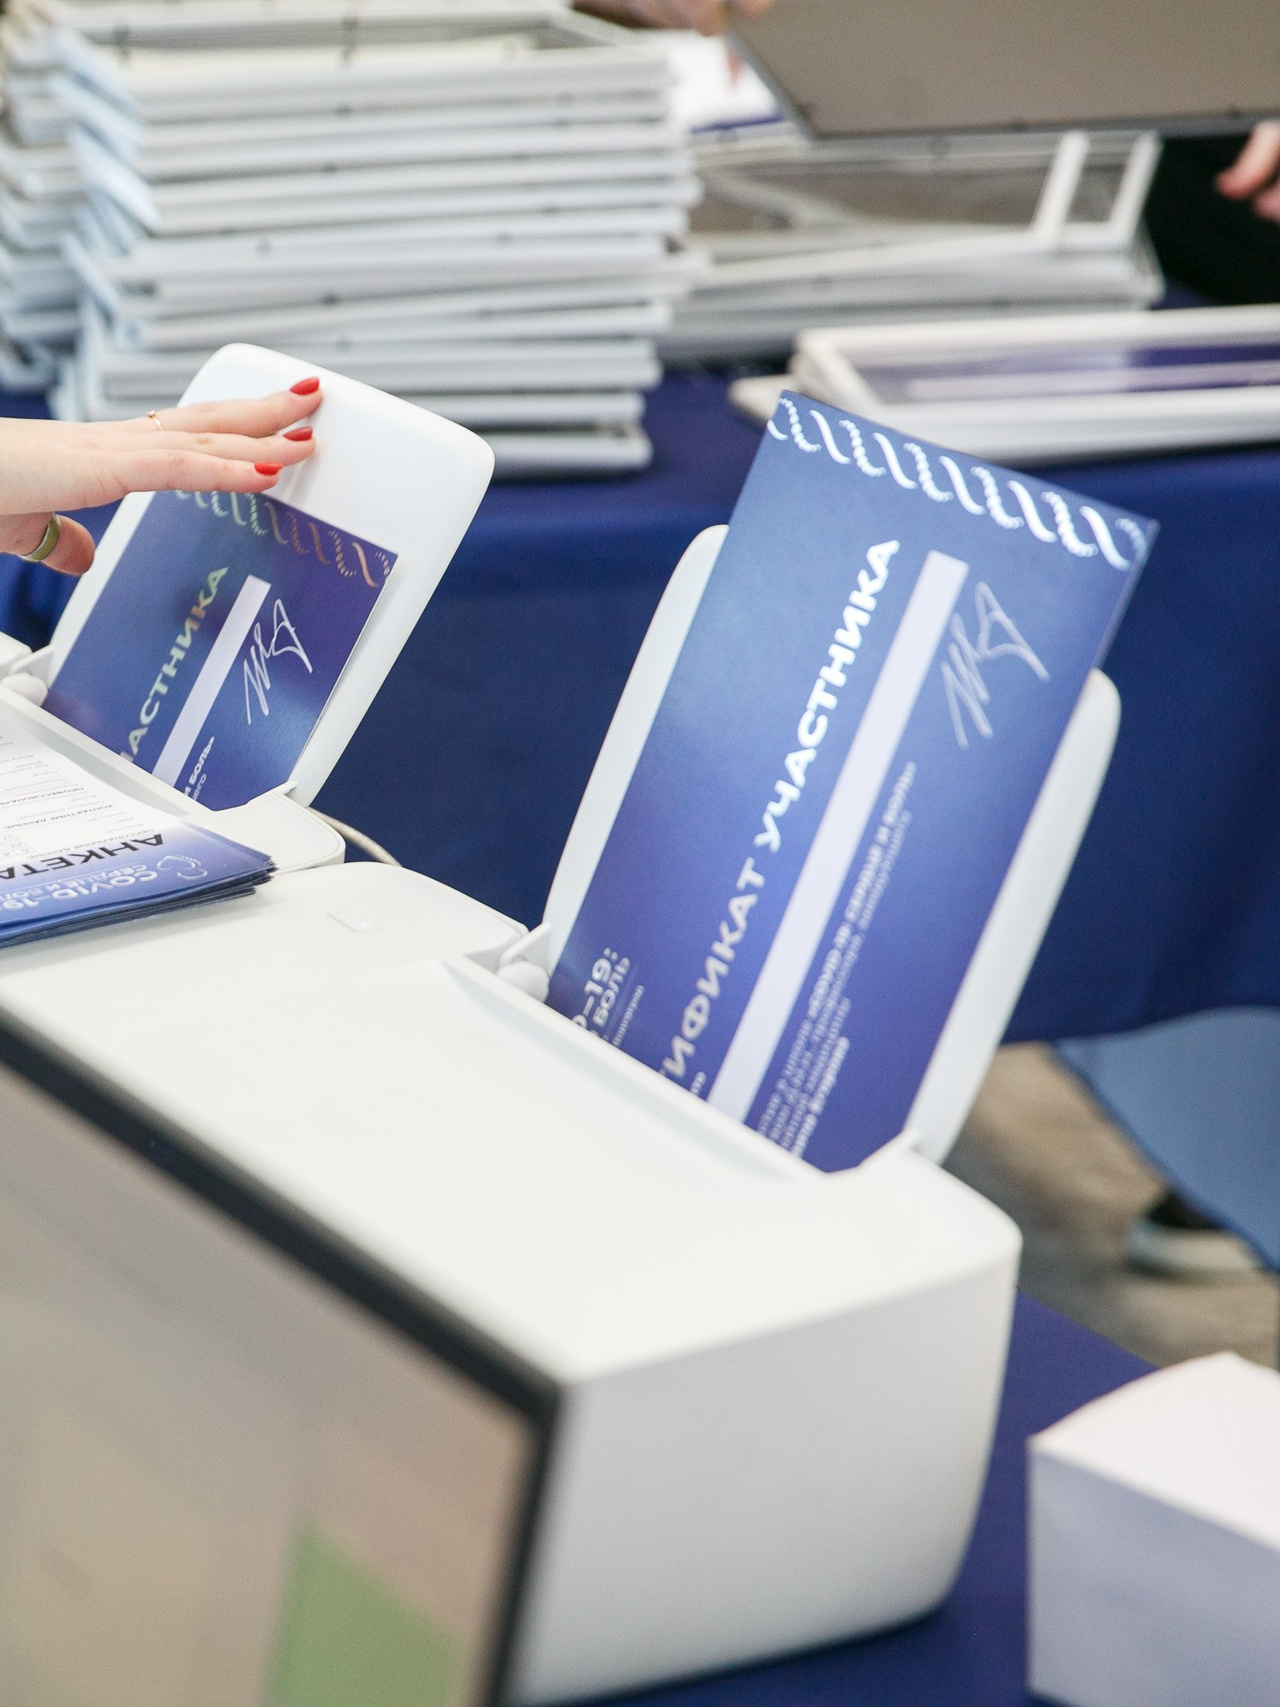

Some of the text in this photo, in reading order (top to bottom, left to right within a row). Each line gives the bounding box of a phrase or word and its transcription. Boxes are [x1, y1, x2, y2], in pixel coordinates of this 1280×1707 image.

[753, 539, 901, 854] УЧАСТНИКА
[61, 864, 148, 890] СЕРДЦЕ
[592, 956, 631, 1028] БОЛЬ
